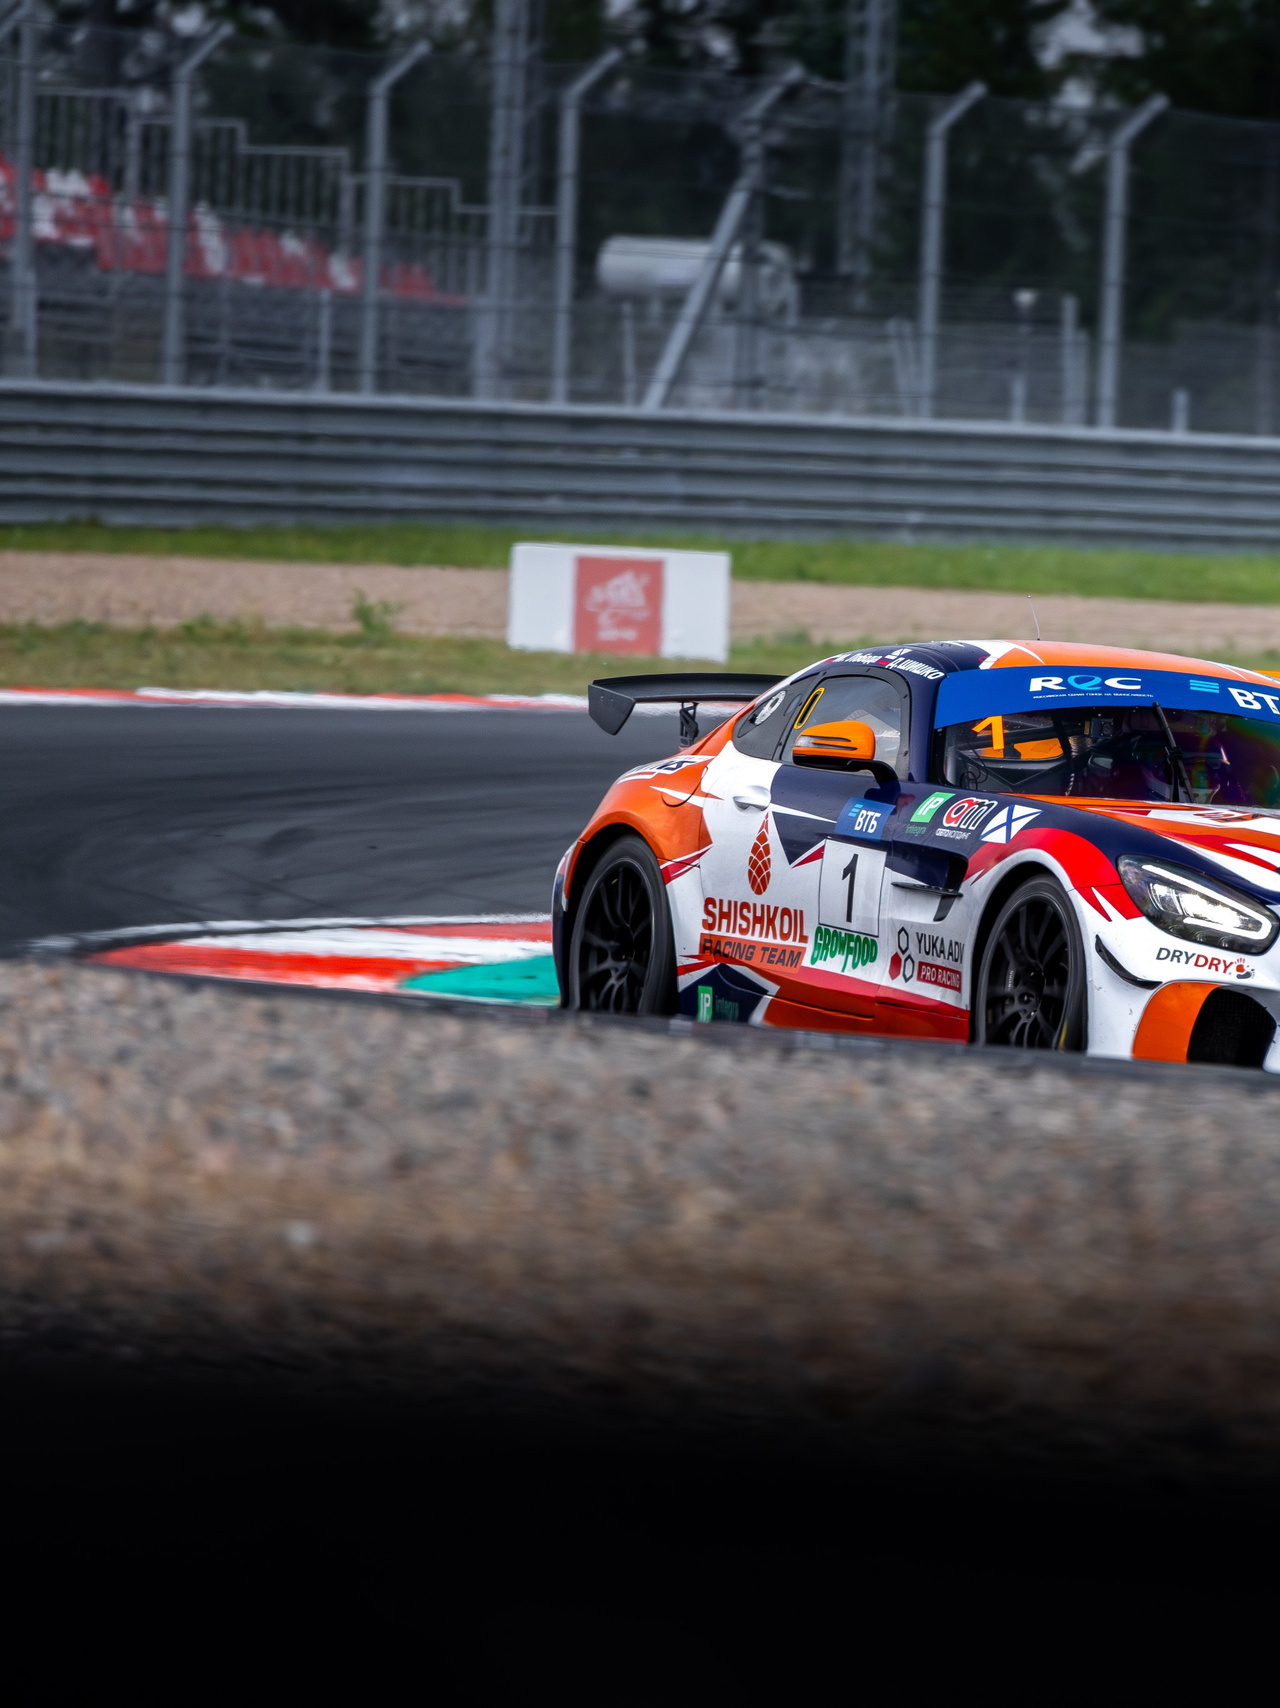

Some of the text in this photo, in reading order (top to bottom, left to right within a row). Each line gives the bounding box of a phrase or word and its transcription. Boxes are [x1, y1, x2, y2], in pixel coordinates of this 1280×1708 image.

[971, 715, 1004, 750] 1
[917, 797, 943, 815] IP
[854, 809, 882, 834] ВТБ
[841, 853, 859, 923] 1
[702, 897, 809, 944] SHISHKOIL
[702, 939, 802, 968] RACING TEAM
[915, 932, 946, 960] YUKA
[920, 965, 960, 988] PRO RACING
